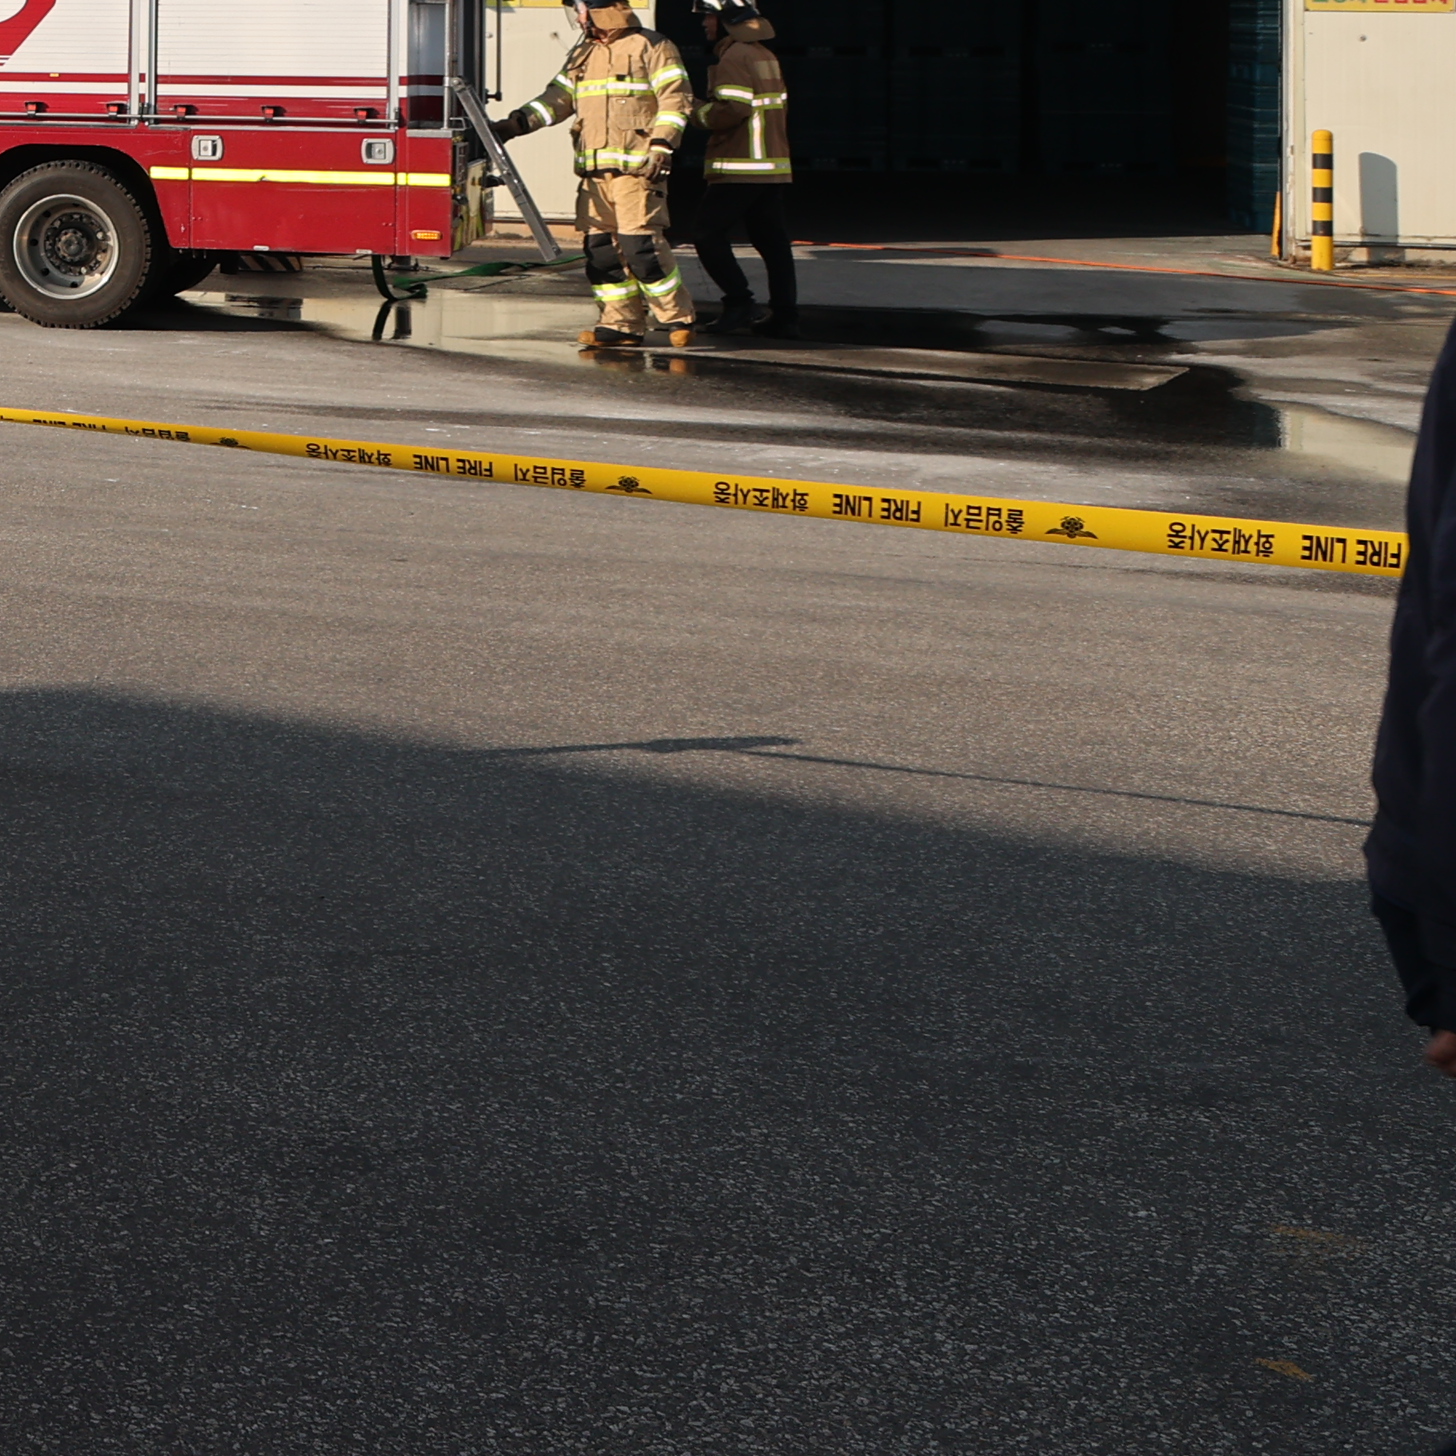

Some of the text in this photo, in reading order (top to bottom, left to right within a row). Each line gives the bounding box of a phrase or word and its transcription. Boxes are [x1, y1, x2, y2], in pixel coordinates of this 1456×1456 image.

[413, 453, 450, 472] LINE
[456, 458, 494, 478] FIRE
[513, 463, 587, 489] 출입금지
[713, 481, 809, 512] 화재조사중
[832, 493, 874, 518] LINE
[880, 498, 922, 523] FIRE
[944, 502, 1025, 535] 출입금지
[1166, 521, 1275, 558] 화재조사중
[1301, 534, 1347, 564] LINE
[1355, 540, 1402, 569] FIRE
